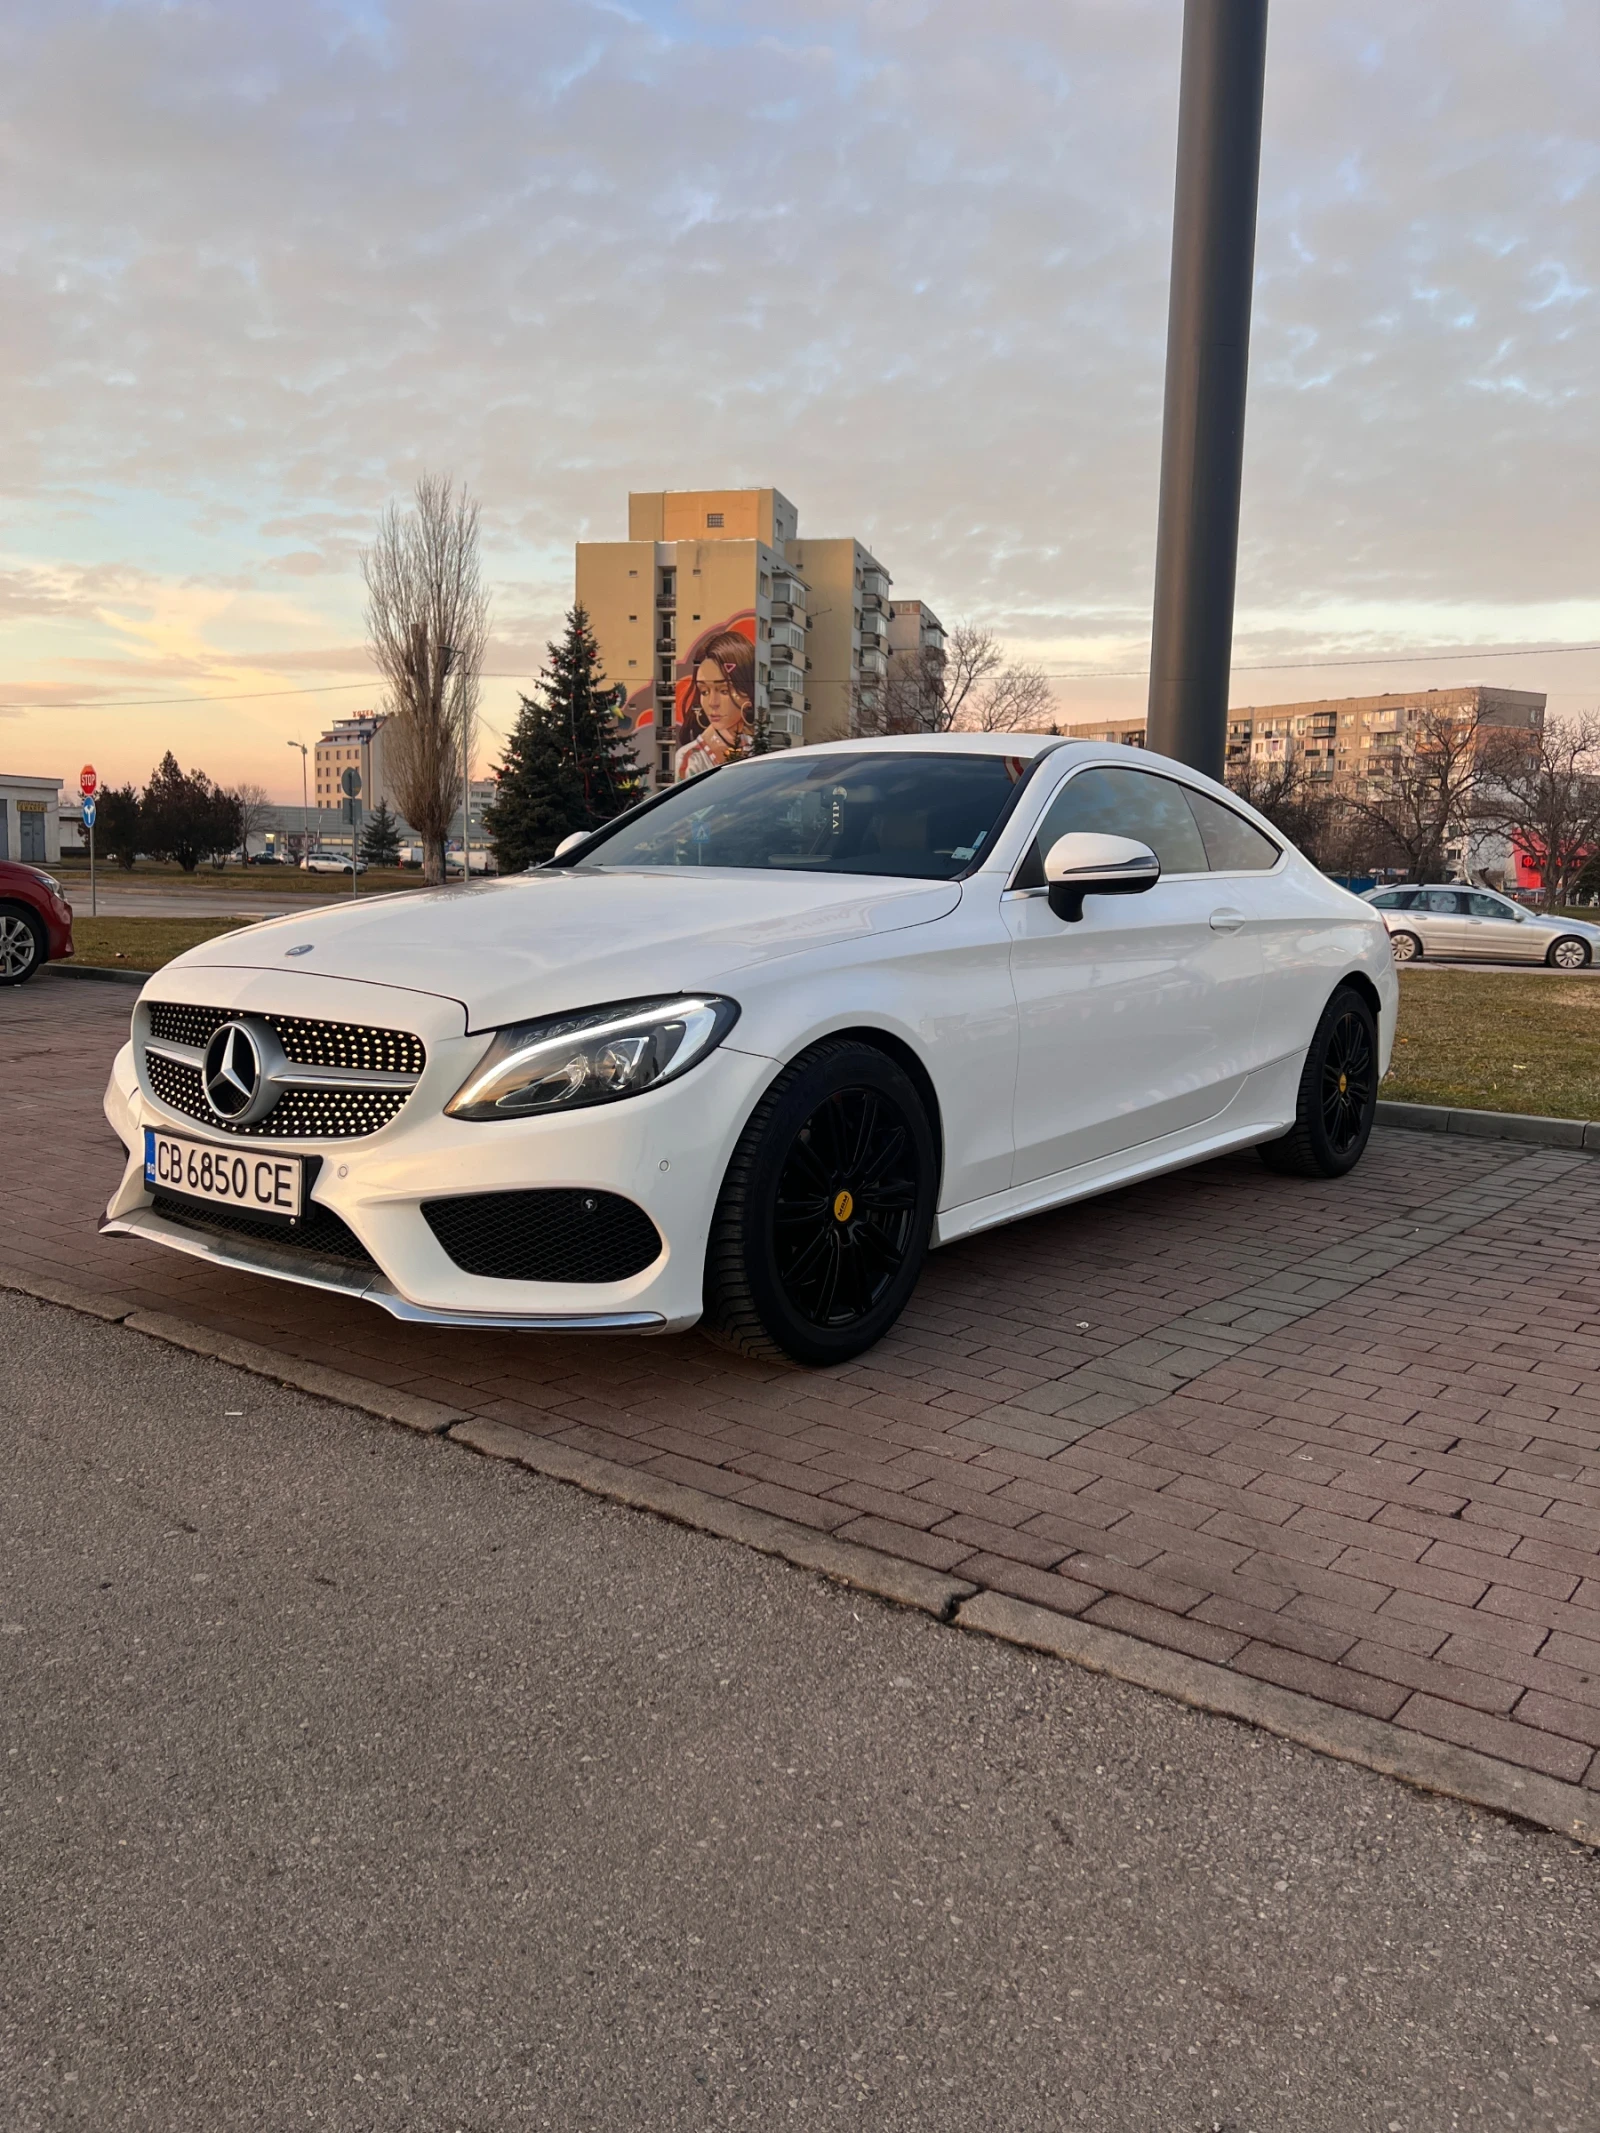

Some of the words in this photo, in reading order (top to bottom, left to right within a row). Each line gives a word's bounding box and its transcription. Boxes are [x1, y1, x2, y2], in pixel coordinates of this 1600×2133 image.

[82, 774, 96, 786] STOP
[832, 801, 840, 829] VIP
[146, 1161, 156, 1175] BG
[158, 1141, 182, 1184] CB
[187, 1149, 248, 1199] 6850
[254, 1161, 293, 1208] CE
